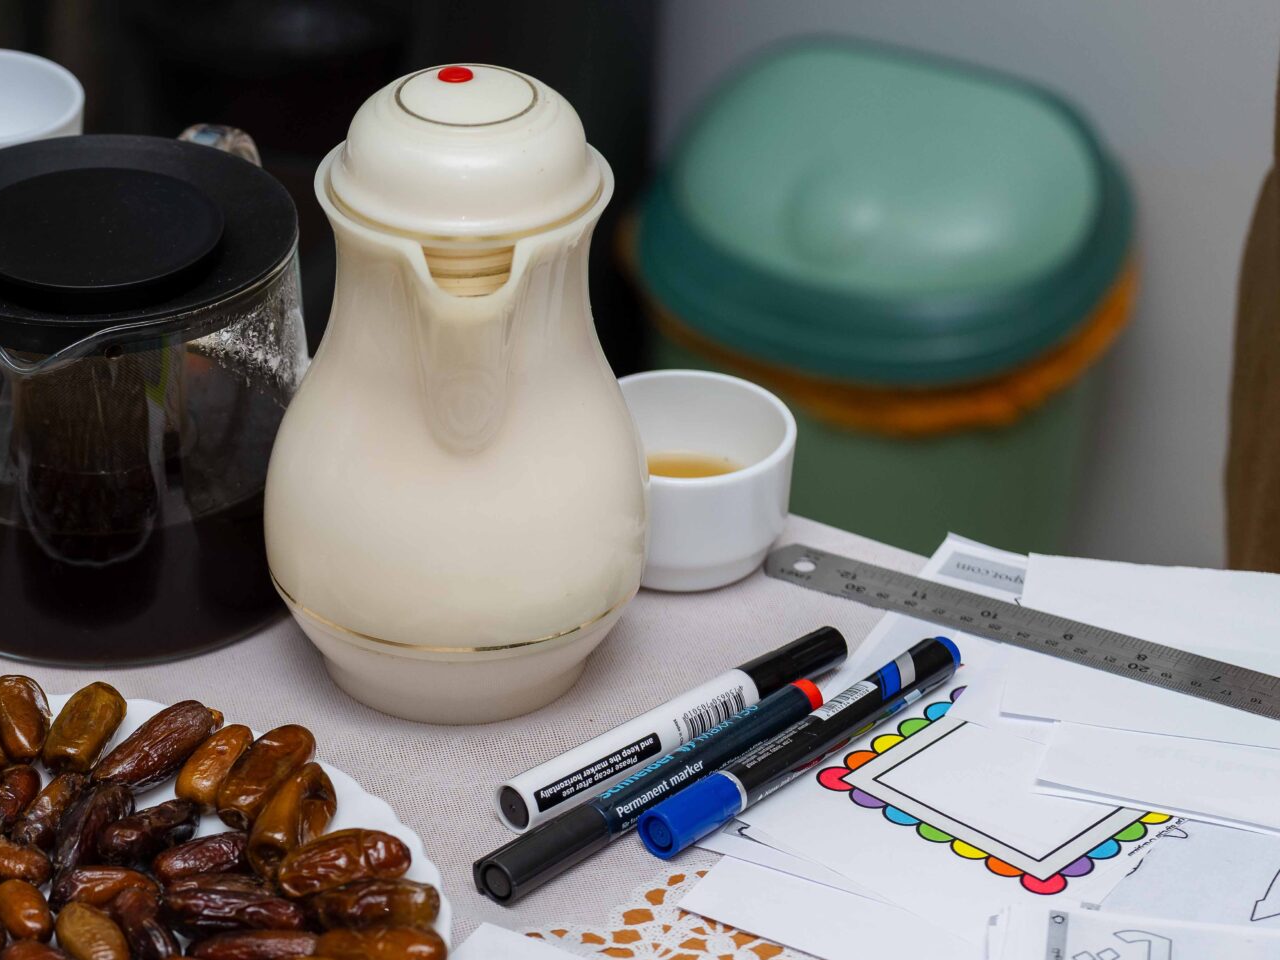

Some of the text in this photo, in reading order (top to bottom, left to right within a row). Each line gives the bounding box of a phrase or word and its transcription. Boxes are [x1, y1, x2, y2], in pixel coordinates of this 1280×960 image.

[540, 737, 654, 799] and keep the marker horizontally
[562, 755, 638, 797] Please recap after use
[616, 778, 669, 817] Permanent
[669, 760, 704, 787] marker
